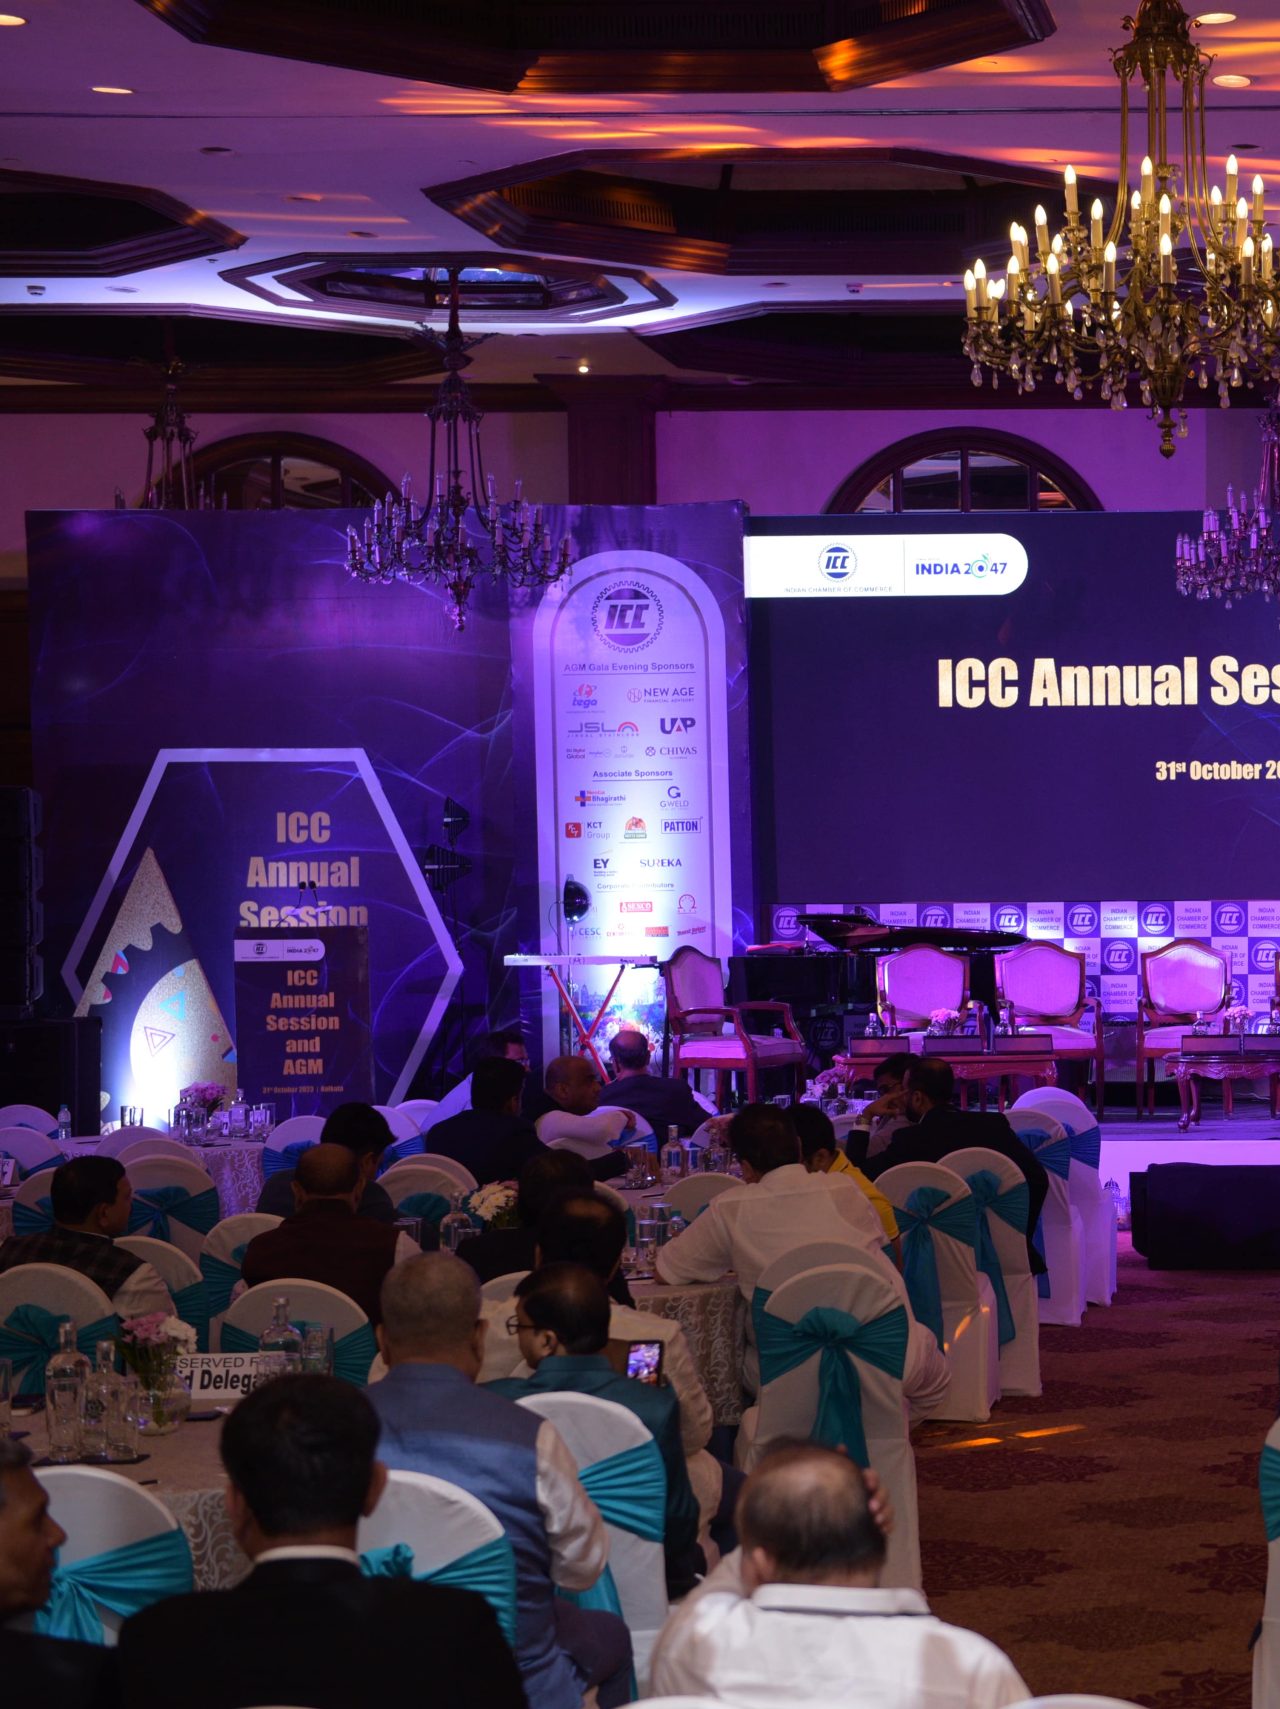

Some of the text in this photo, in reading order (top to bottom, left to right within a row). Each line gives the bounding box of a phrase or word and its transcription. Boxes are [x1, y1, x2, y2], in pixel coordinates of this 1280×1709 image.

[825, 555, 849, 570] ICC
[915, 563, 961, 575] INDIA
[604, 604, 650, 629] ICC
[612, 663, 648, 672] Evening
[651, 662, 695, 671] Sponsors
[937, 658, 1018, 708] ICC
[1029, 656, 1198, 707] Annual
[644, 687, 695, 696] NEW AGE
[660, 746, 697, 755] CHIVAS
[593, 769, 673, 778] Associate Sponsors
[1155, 761, 1186, 780] 31st
[1189, 760, 1262, 779] October
[592, 795, 626, 803] Bhagirathi
[276, 811, 331, 844] ICC
[586, 821, 602, 829] KCT
[664, 820, 698, 832] PATTON
[587, 831, 611, 840] Group
[593, 858, 609, 869] EY
[246, 856, 360, 888] Annual
[239, 901, 368, 927] Session
[1072, 914, 1092, 925] ICC
[1146, 913, 1165, 925] ICC
[1220, 913, 1239, 924] ICC
[1000, 915, 1018, 926] ICC
[1109, 951, 1128, 962] ICC
[287, 969, 318, 986] ICC
[270, 992, 335, 1008] Annual
[266, 1014, 340, 1031] Session
[286, 1036, 321, 1053] and
[283, 1058, 324, 1075] AGM
